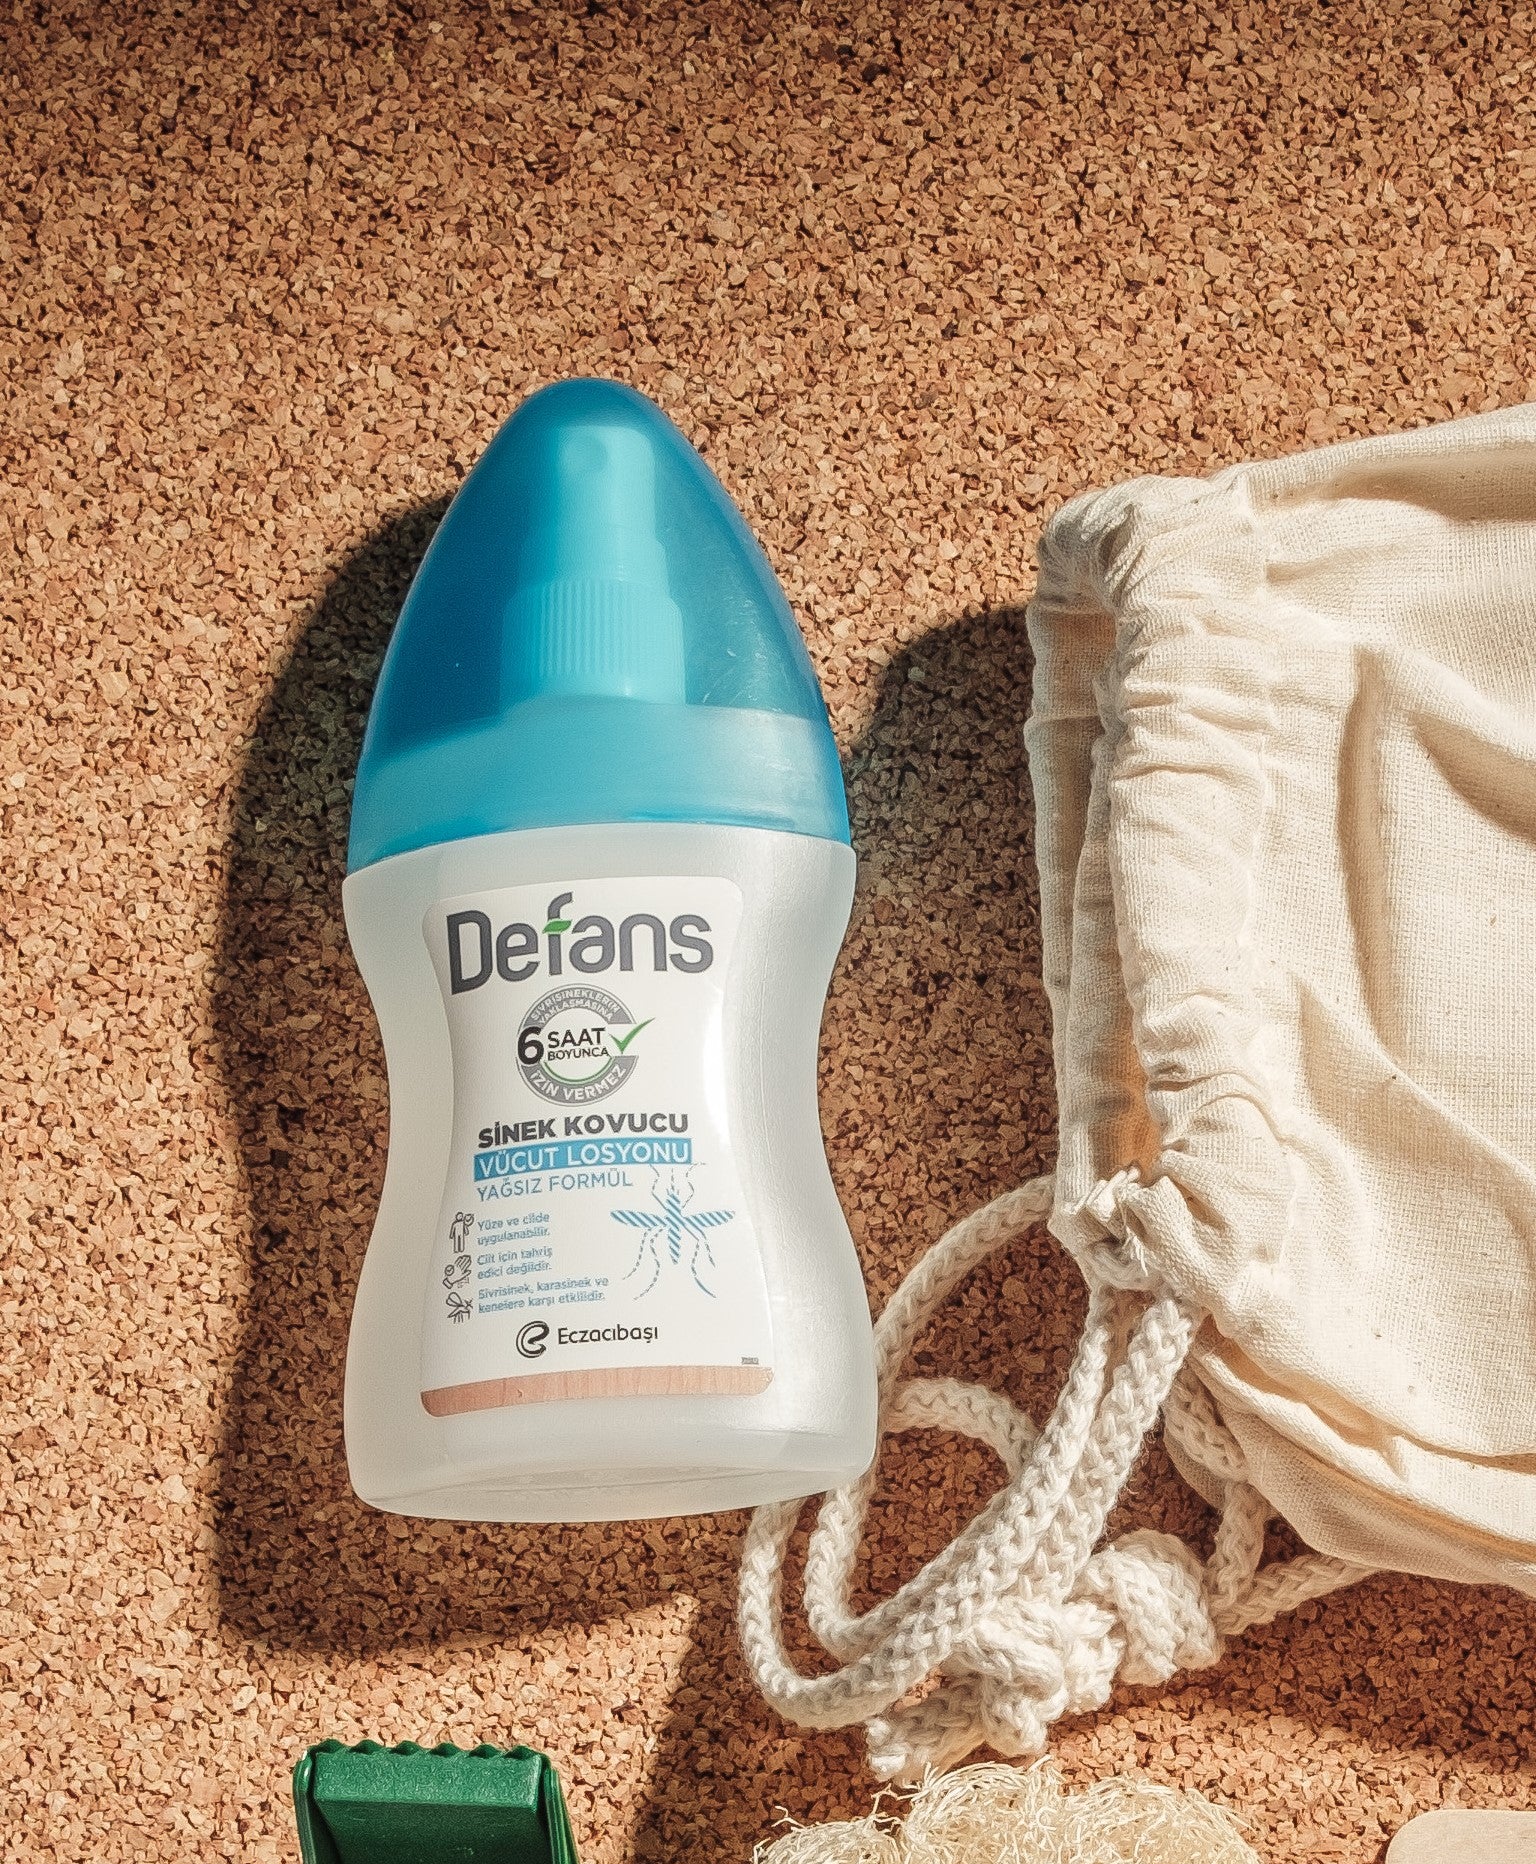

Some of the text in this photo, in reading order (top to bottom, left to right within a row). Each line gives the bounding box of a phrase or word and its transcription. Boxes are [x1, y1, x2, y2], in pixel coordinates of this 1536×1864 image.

[447, 892, 712, 994] Defans
[517, 1026, 606, 1065] 6 SAAT
[547, 1047, 610, 1061] BOYUNCA
[563, 1064, 627, 1101] VERMEZ
[478, 1113, 688, 1149] SİNEK KOVUCU
[478, 1141, 688, 1178] VÜCUT LOSYONU
[477, 1168, 633, 1202] YAĞSIZ FORMÜL
[507, 1216, 519, 1226] ve
[557, 1323, 659, 1344] Eczacıbaşı
